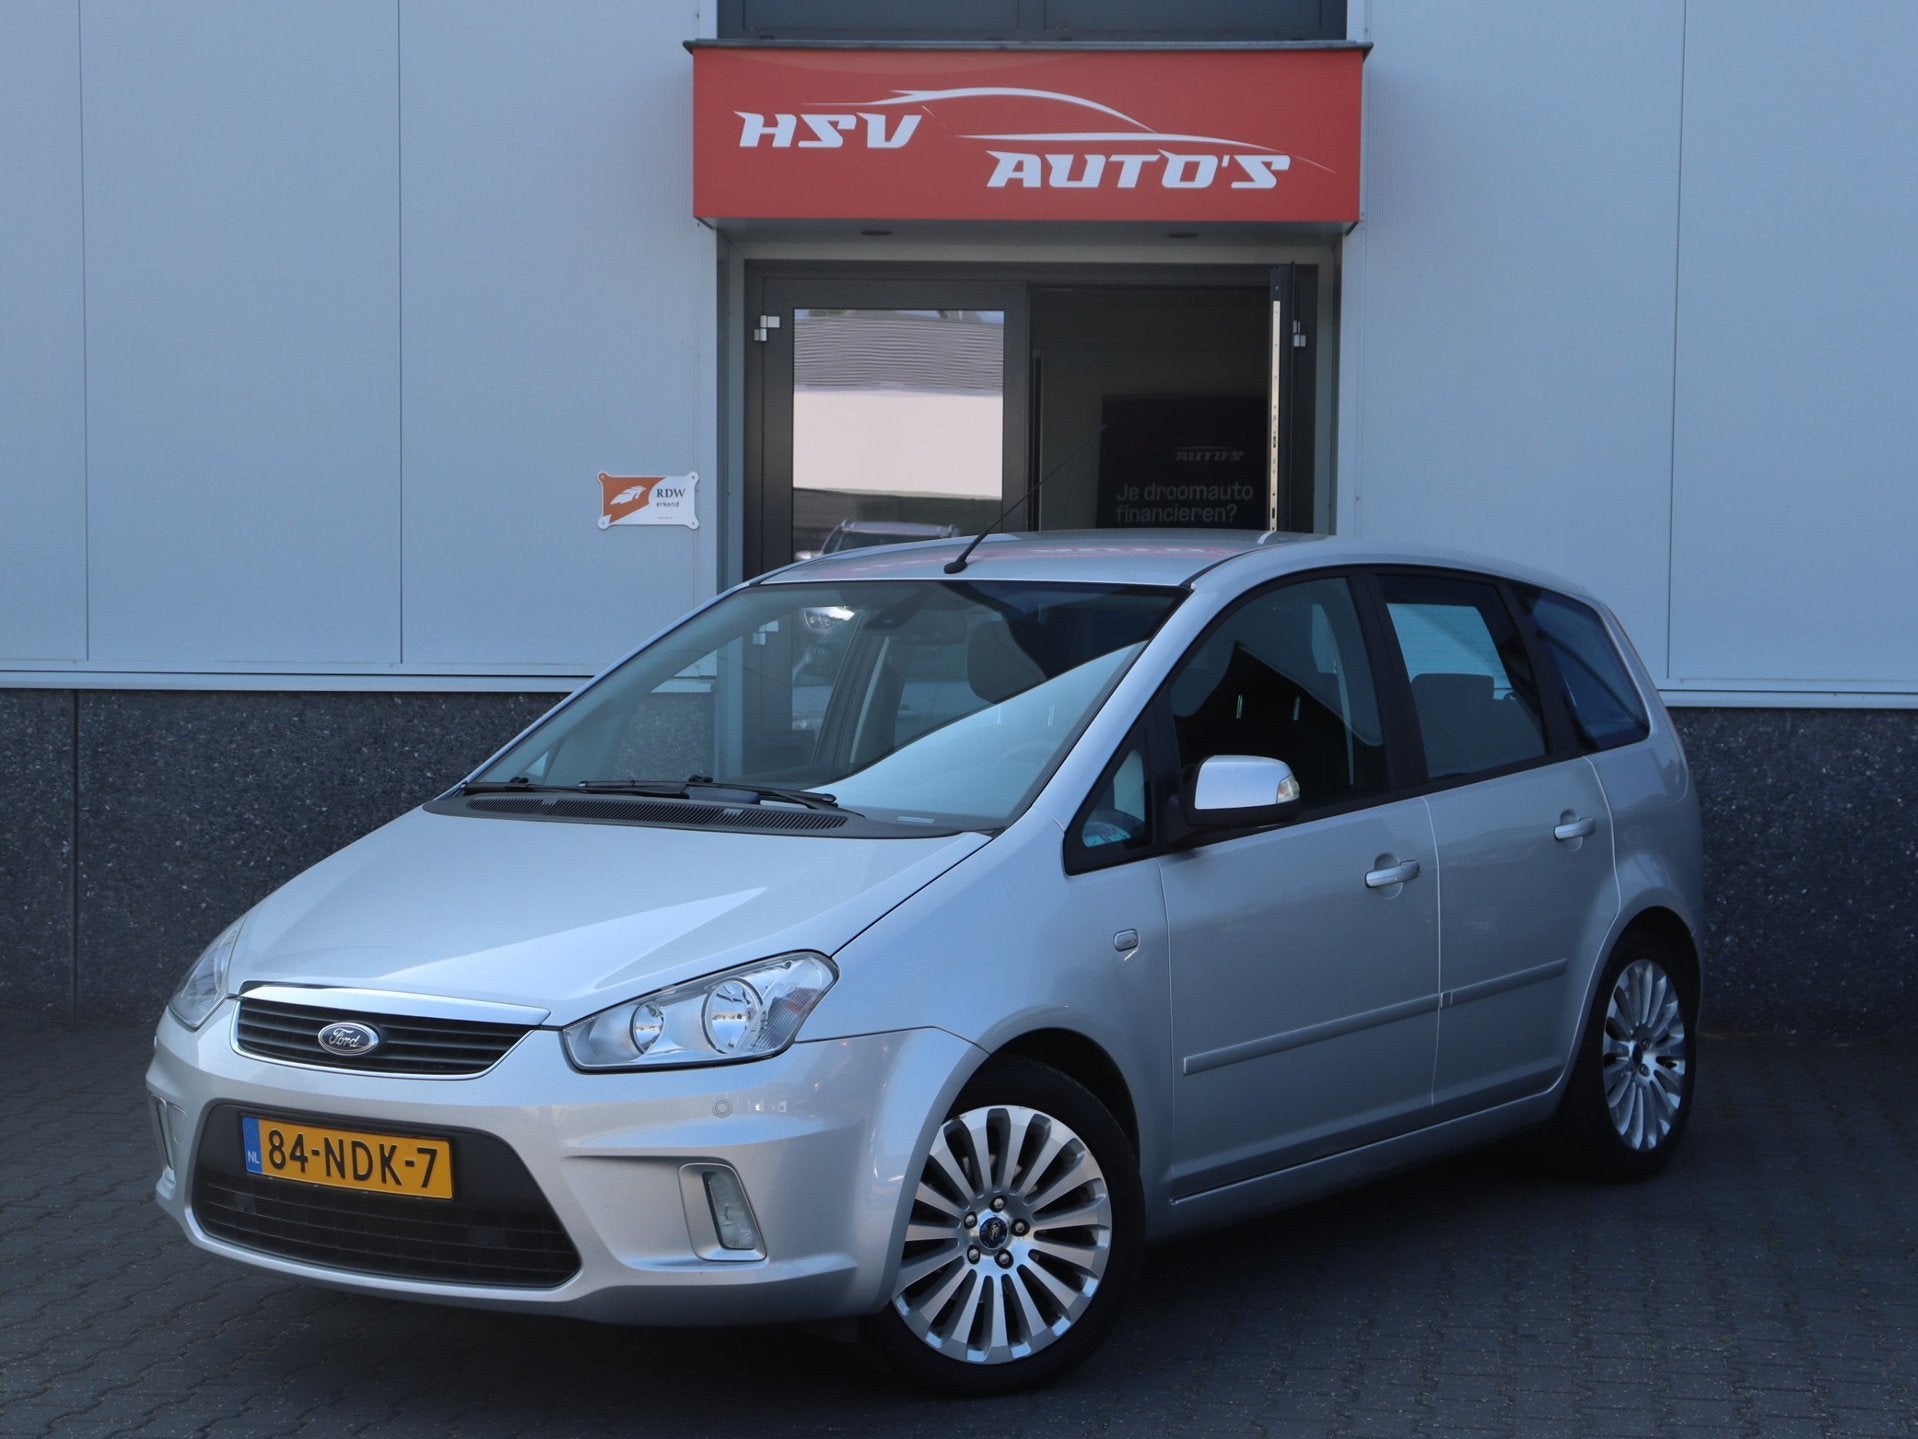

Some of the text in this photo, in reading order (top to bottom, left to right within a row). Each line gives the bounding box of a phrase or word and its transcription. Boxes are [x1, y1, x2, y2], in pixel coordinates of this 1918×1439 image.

[733, 110, 922, 148] HSV
[985, 149, 1291, 189] AUTO'S
[656, 488, 685, 498] RDW
[1116, 481, 1254, 501] Je droomauto
[1115, 503, 1238, 523] financieren?
[328, 1027, 361, 1048] Ford
[247, 1151, 260, 1164] NL
[268, 1128, 438, 1189] 84-NDK-7
